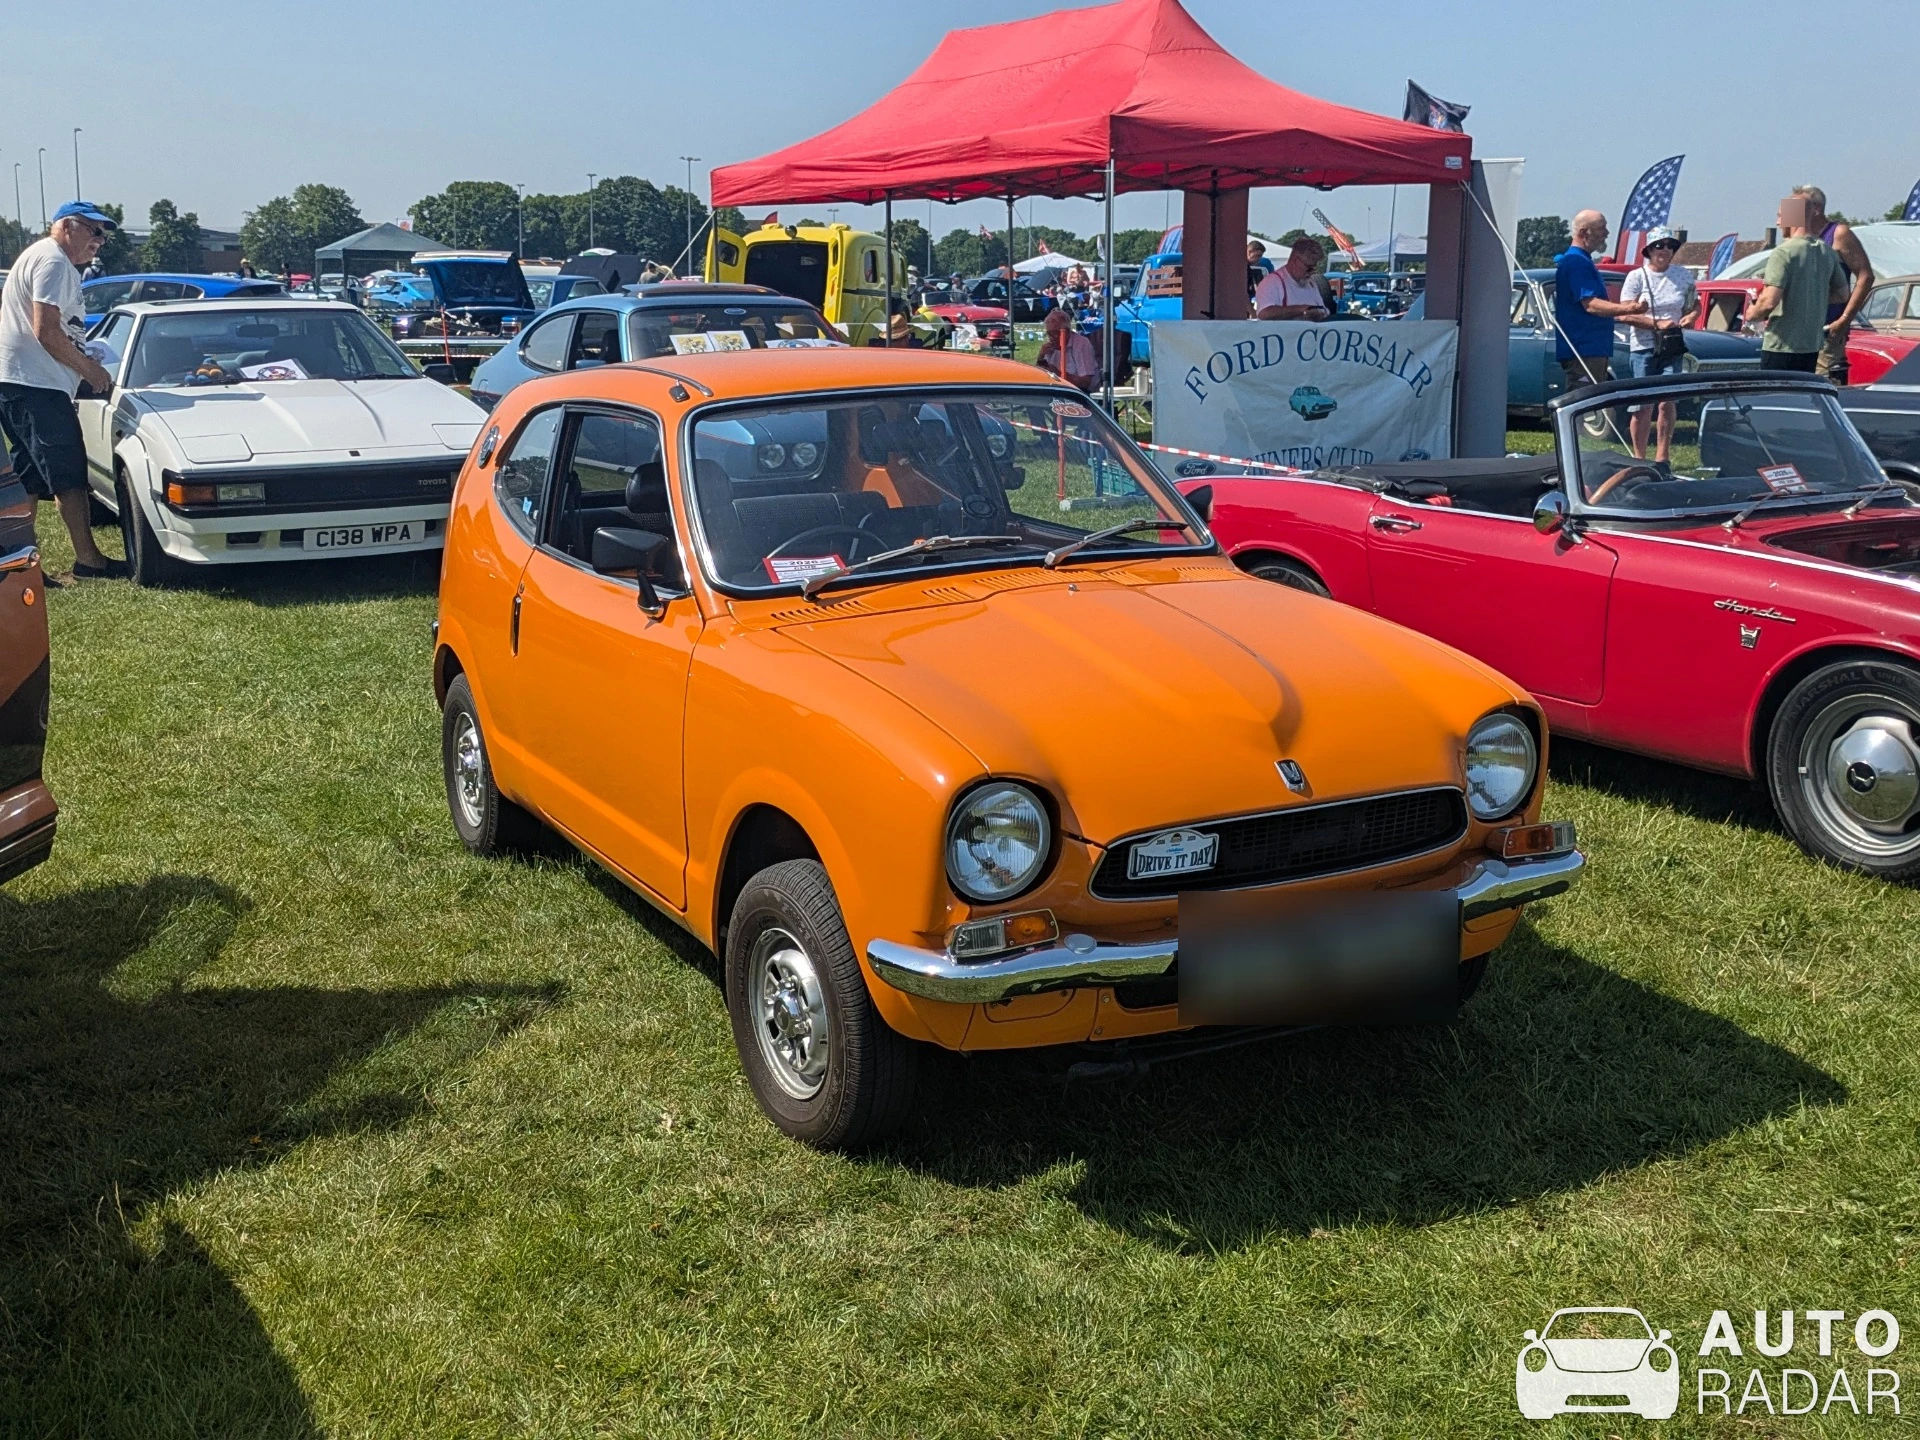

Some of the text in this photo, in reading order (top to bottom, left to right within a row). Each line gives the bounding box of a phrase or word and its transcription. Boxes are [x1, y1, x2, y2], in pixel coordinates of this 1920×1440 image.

[1184, 329, 1432, 404] FORD CORSAIR
[1184, 463, 1208, 475] Ford
[316, 524, 411, 547] C138 WPA
[1714, 599, 1796, 621] Honda
[1138, 855, 1172, 873] DRIVE
[1174, 854, 1188, 869] IT
[1190, 845, 1213, 867] DAY
